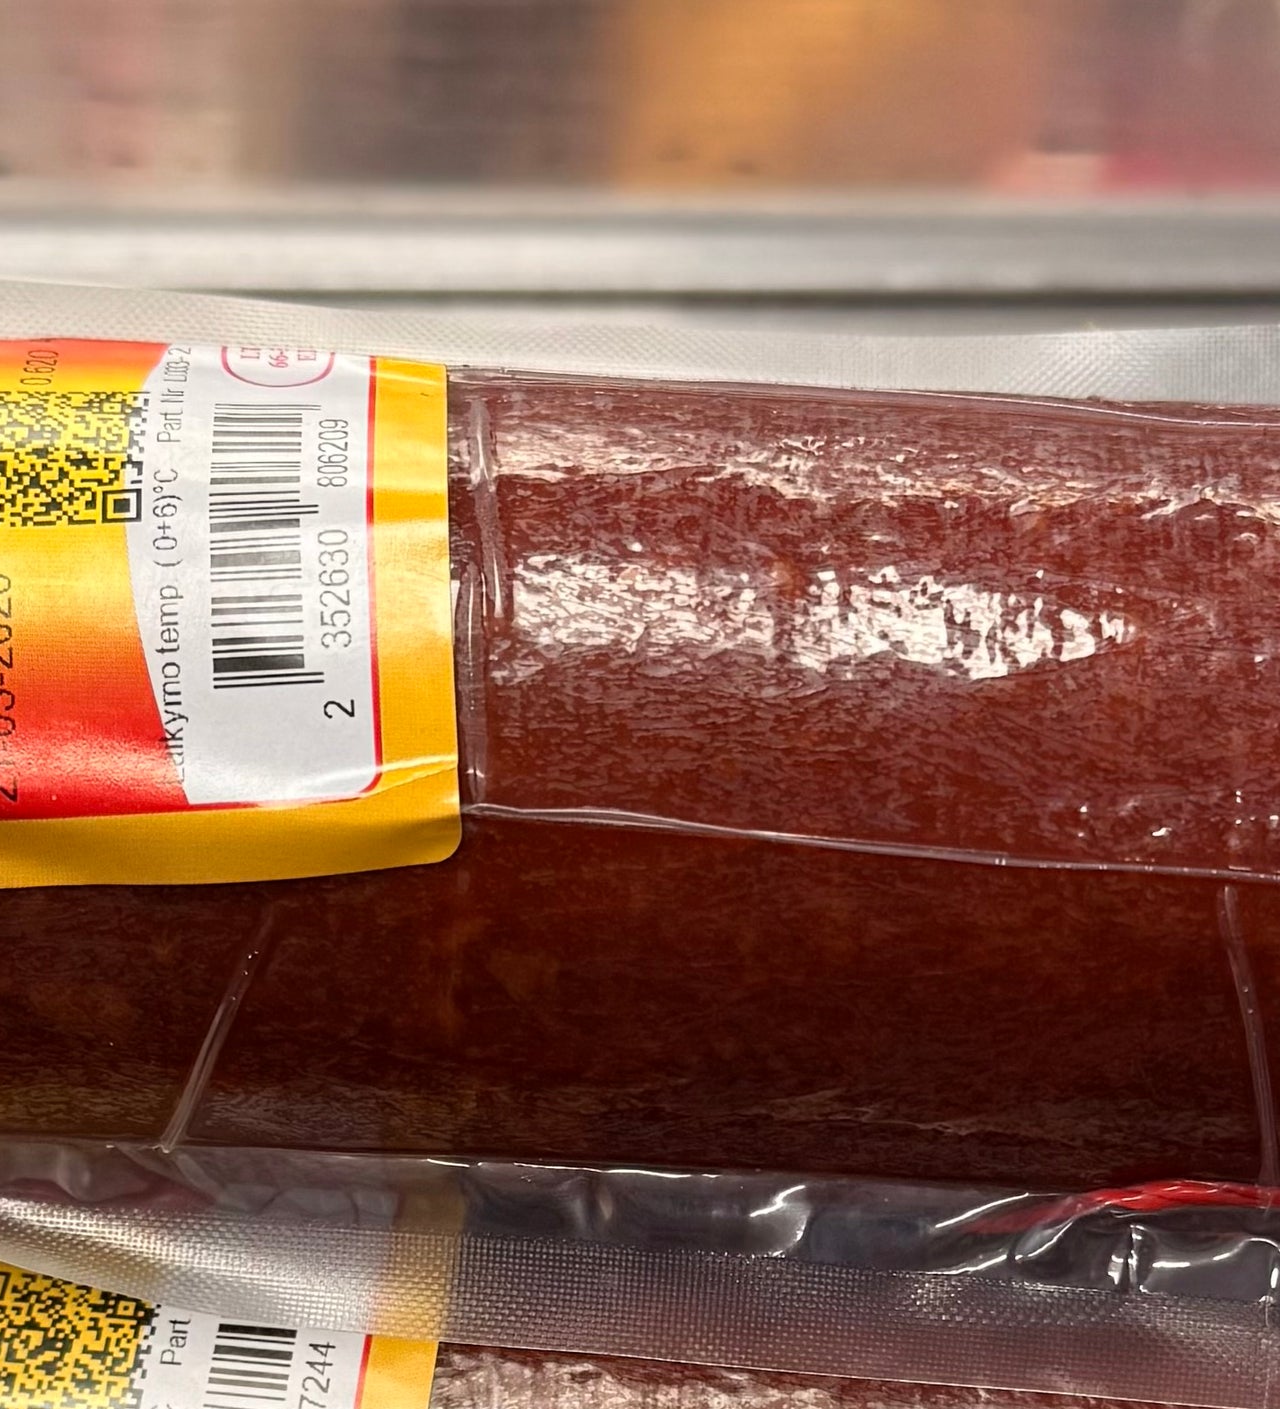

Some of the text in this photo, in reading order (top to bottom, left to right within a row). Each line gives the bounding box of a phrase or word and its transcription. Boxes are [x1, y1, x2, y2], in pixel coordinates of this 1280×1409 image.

[316, 418, 355, 719] 2 352630 806209
